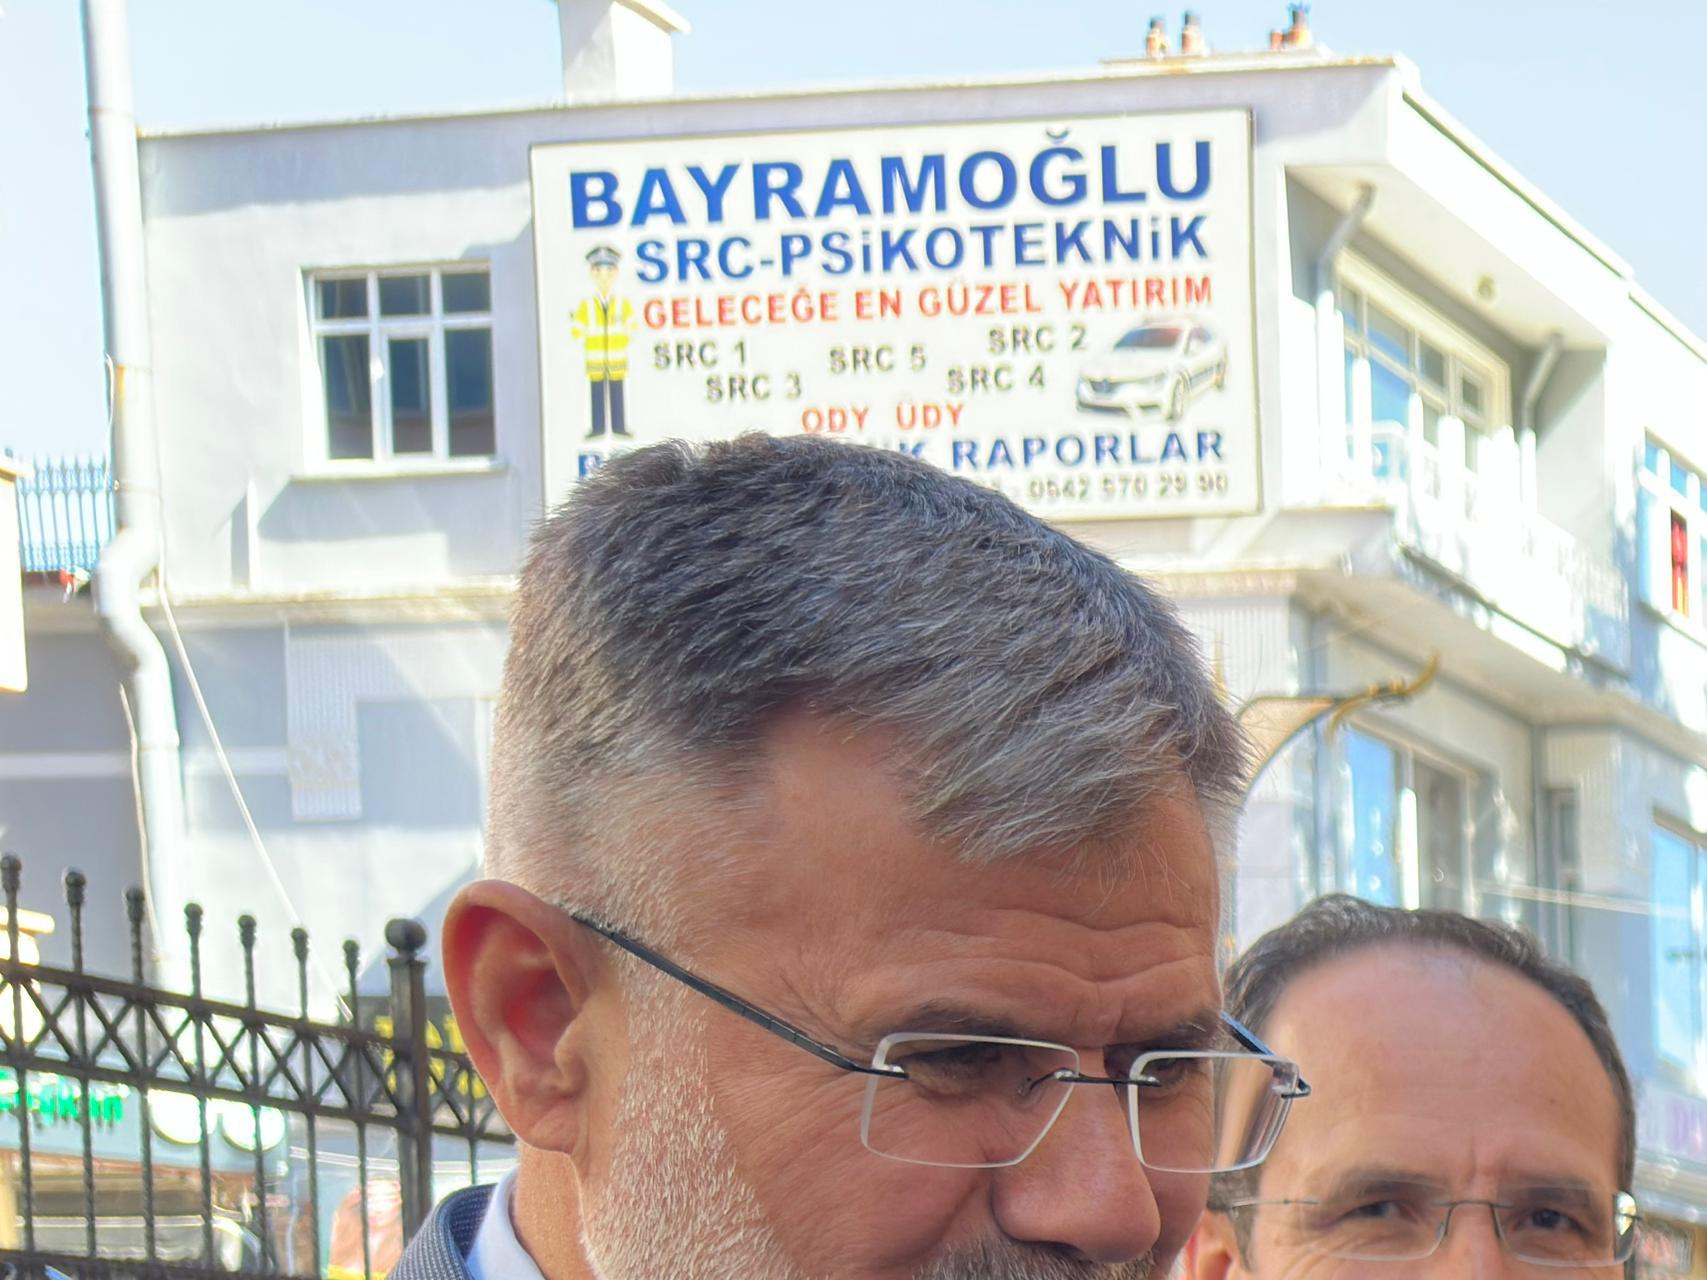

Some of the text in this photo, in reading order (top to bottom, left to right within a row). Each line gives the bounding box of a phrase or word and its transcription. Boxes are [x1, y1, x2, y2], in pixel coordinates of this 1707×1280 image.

[570, 131, 1212, 229] BAYRAMOĞLU
[643, 275, 1214, 330] GELECEĞE EN GÜZEL YATIRIM
[653, 337, 748, 371] SRC 1
[987, 323, 1088, 355] SRC 2
[828, 344, 927, 375] SRC 5
[705, 371, 802, 401] SRC 3
[947, 362, 1046, 395] SRC 4
[801, 404, 870, 434] ODY
[951, 430, 1224, 472] RAPORLAR
